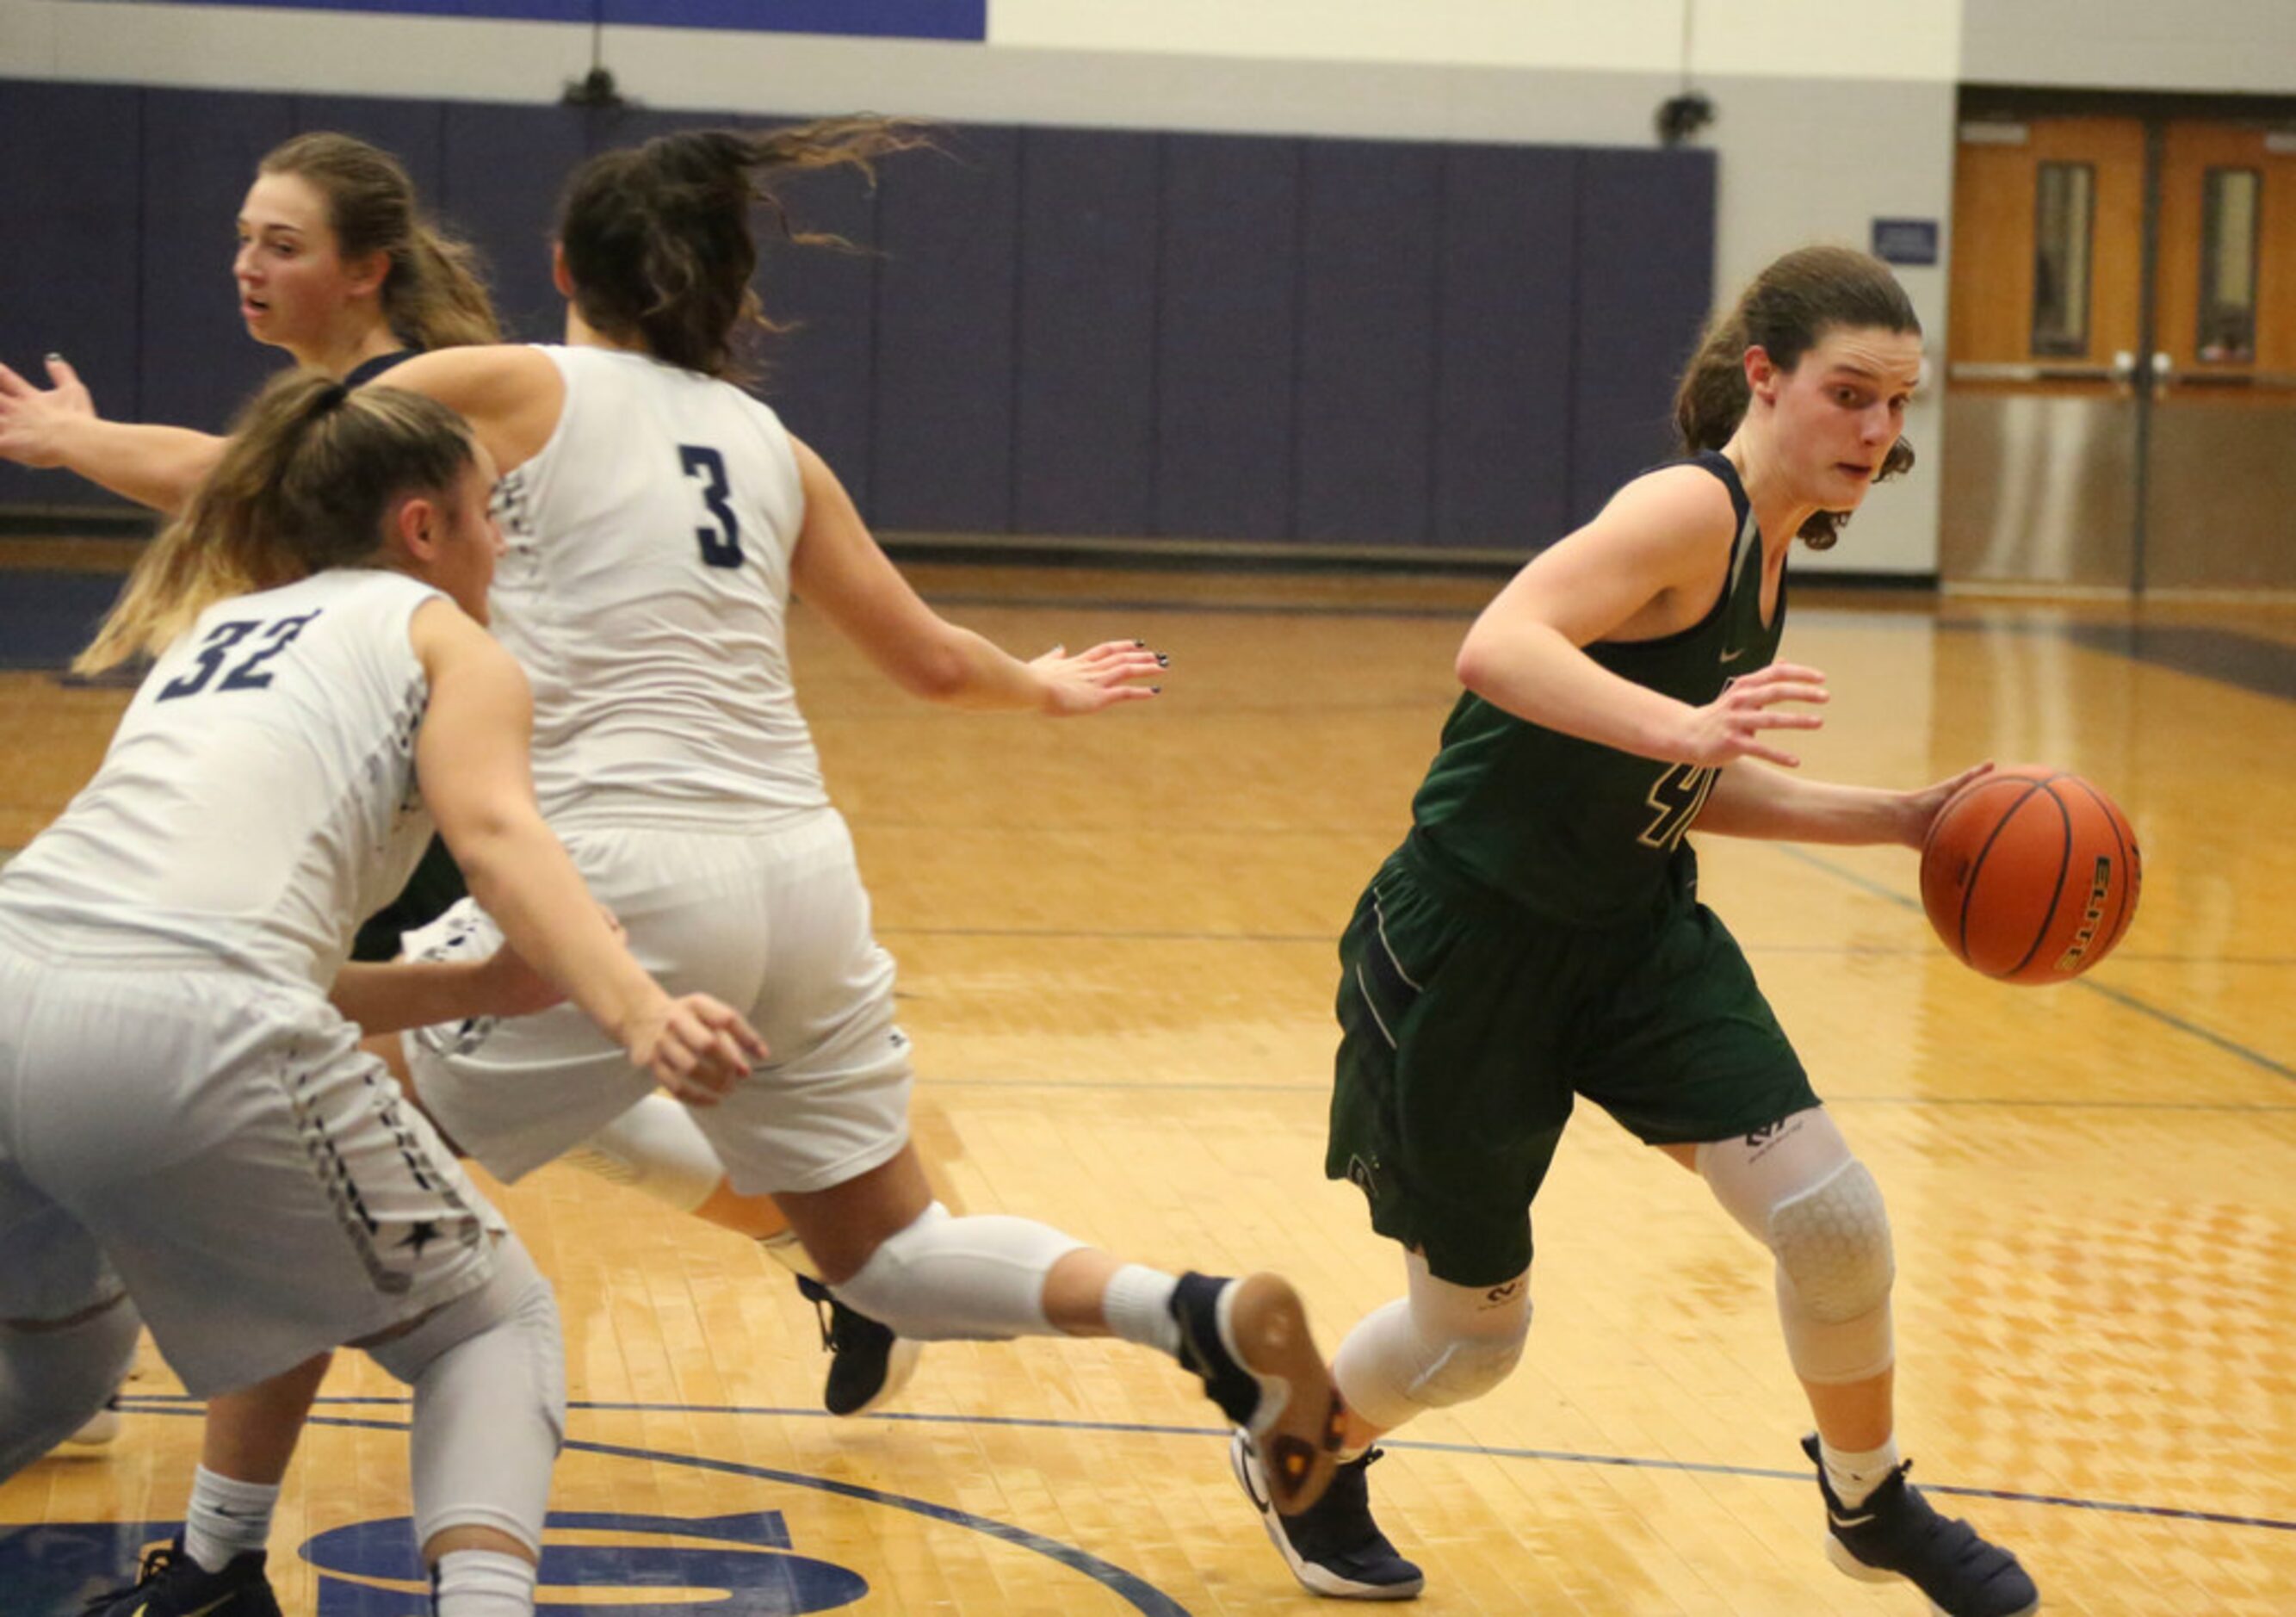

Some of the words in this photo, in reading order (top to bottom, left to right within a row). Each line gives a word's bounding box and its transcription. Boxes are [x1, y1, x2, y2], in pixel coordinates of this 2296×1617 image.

[678, 444, 745, 569] 3
[154, 607, 324, 703] 32
[2054, 856, 2111, 970] ELITE
